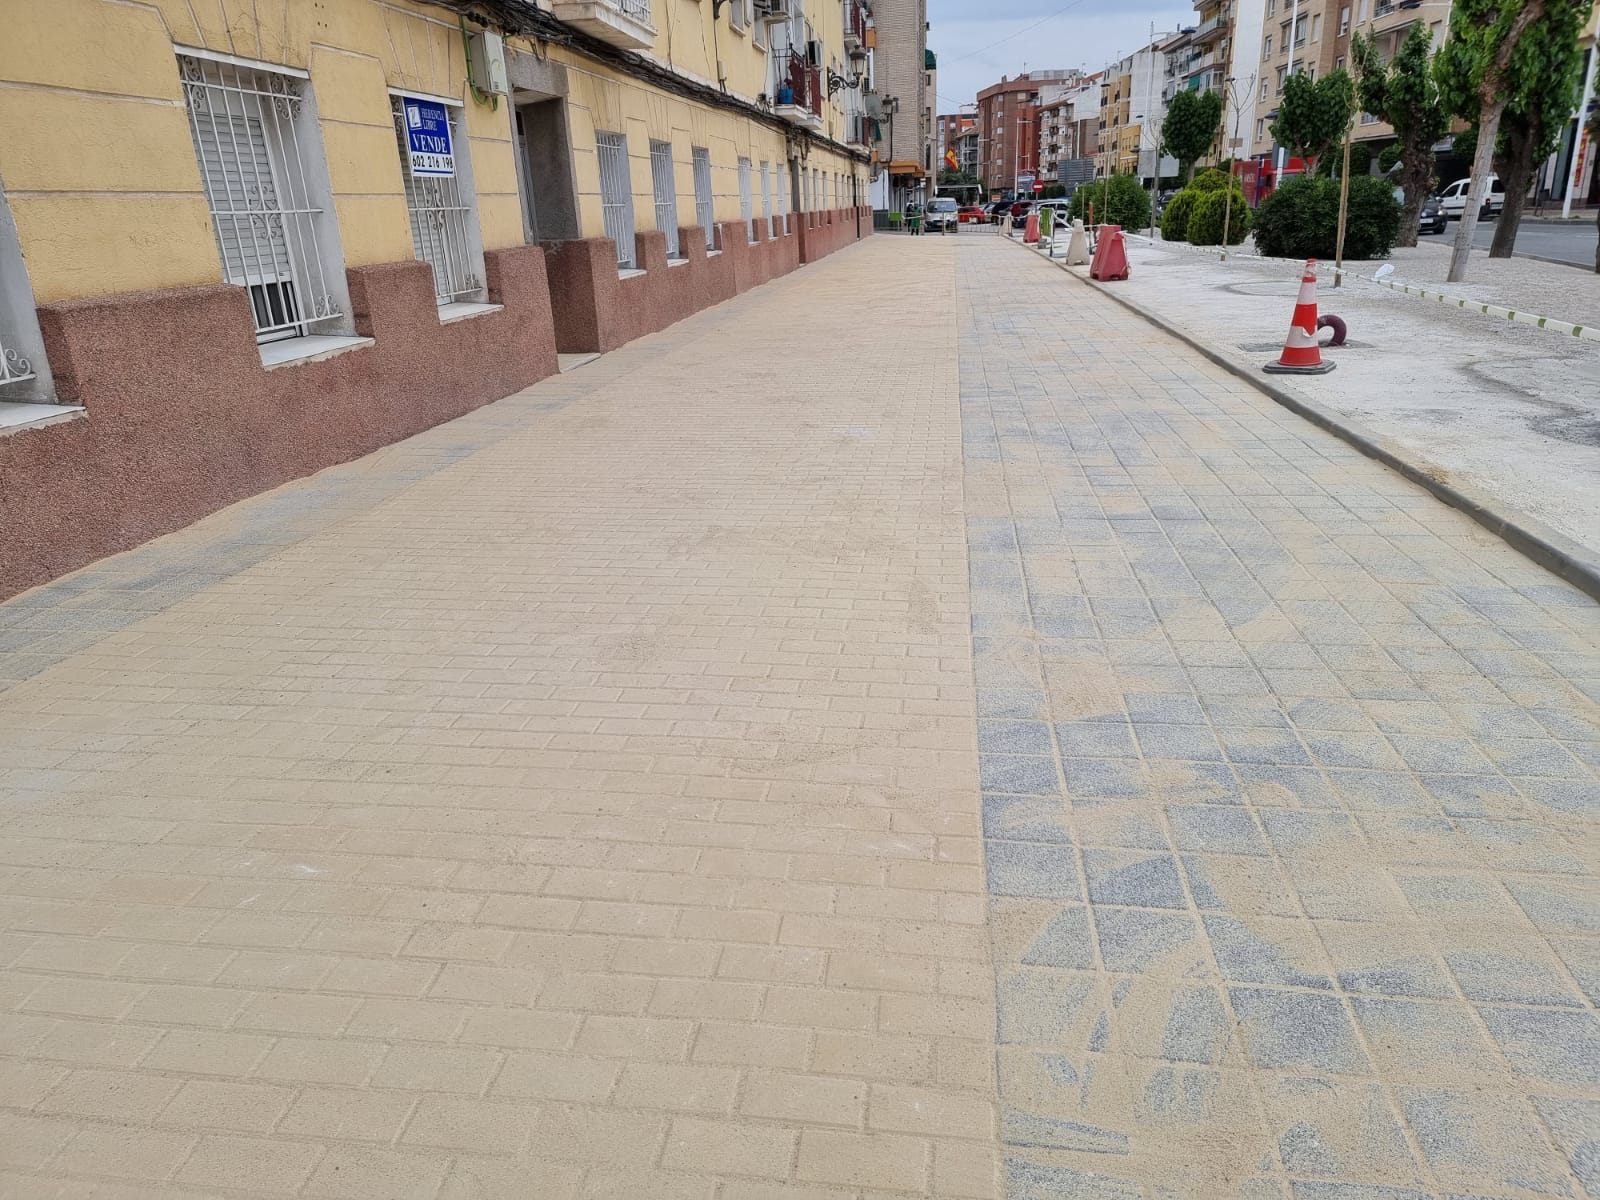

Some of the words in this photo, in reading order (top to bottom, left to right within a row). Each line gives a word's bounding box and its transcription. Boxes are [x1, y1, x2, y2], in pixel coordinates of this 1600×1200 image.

[412, 134, 447, 153] VENDE
[412, 155, 425, 167] 602
[427, 156, 440, 168] 216
[442, 157, 453, 168] 198
